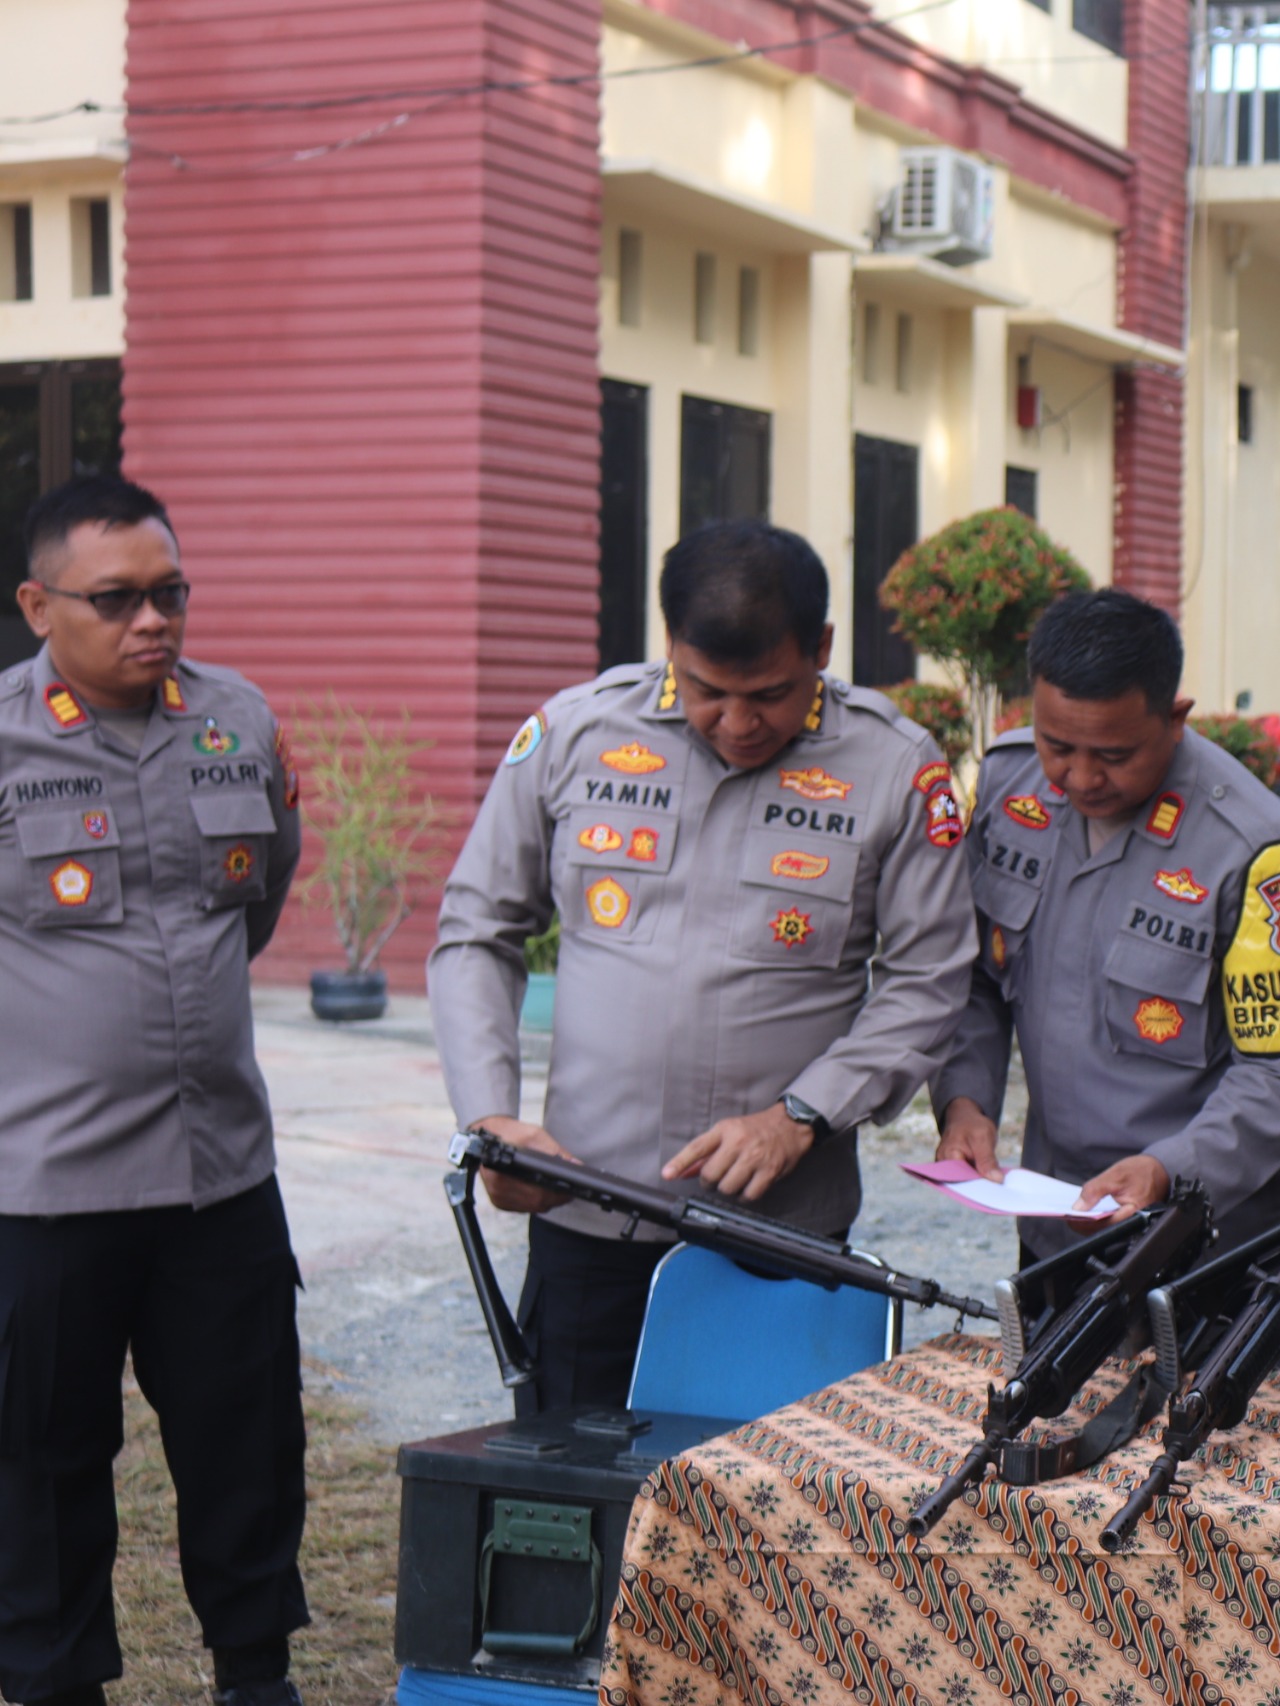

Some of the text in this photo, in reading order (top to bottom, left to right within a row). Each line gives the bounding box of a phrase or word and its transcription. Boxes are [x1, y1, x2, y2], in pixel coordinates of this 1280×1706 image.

[16, 776, 102, 802] HARYONO
[191, 763, 259, 786] POLRI
[586, 780, 671, 809] YAMIN
[764, 803, 856, 836] POLRI
[1129, 907, 1209, 952] POLRI
